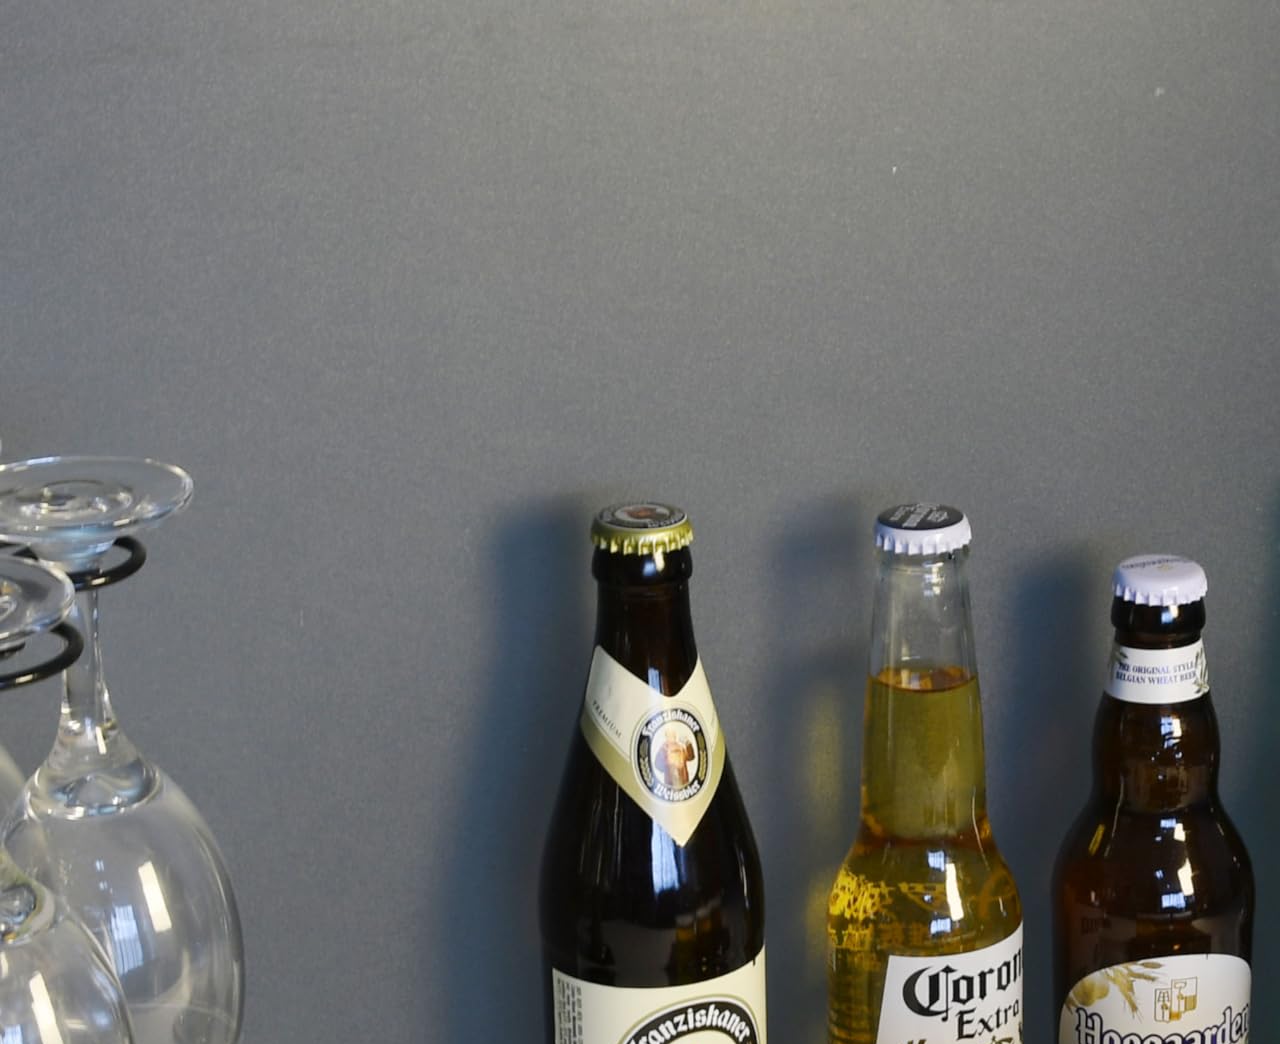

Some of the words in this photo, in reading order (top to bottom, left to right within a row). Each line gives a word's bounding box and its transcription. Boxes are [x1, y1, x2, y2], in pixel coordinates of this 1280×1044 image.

[1116, 671, 1146, 683] BELGIAN
[1147, 675, 1177, 685] WHEAT
[1180, 671, 1197, 681] BEER
[1132, 664, 1169, 674] ORIGINAL
[1174, 661, 1194, 673] STYLE
[903, 948, 1024, 1022] Coron
[957, 999, 1020, 1041] Extra
